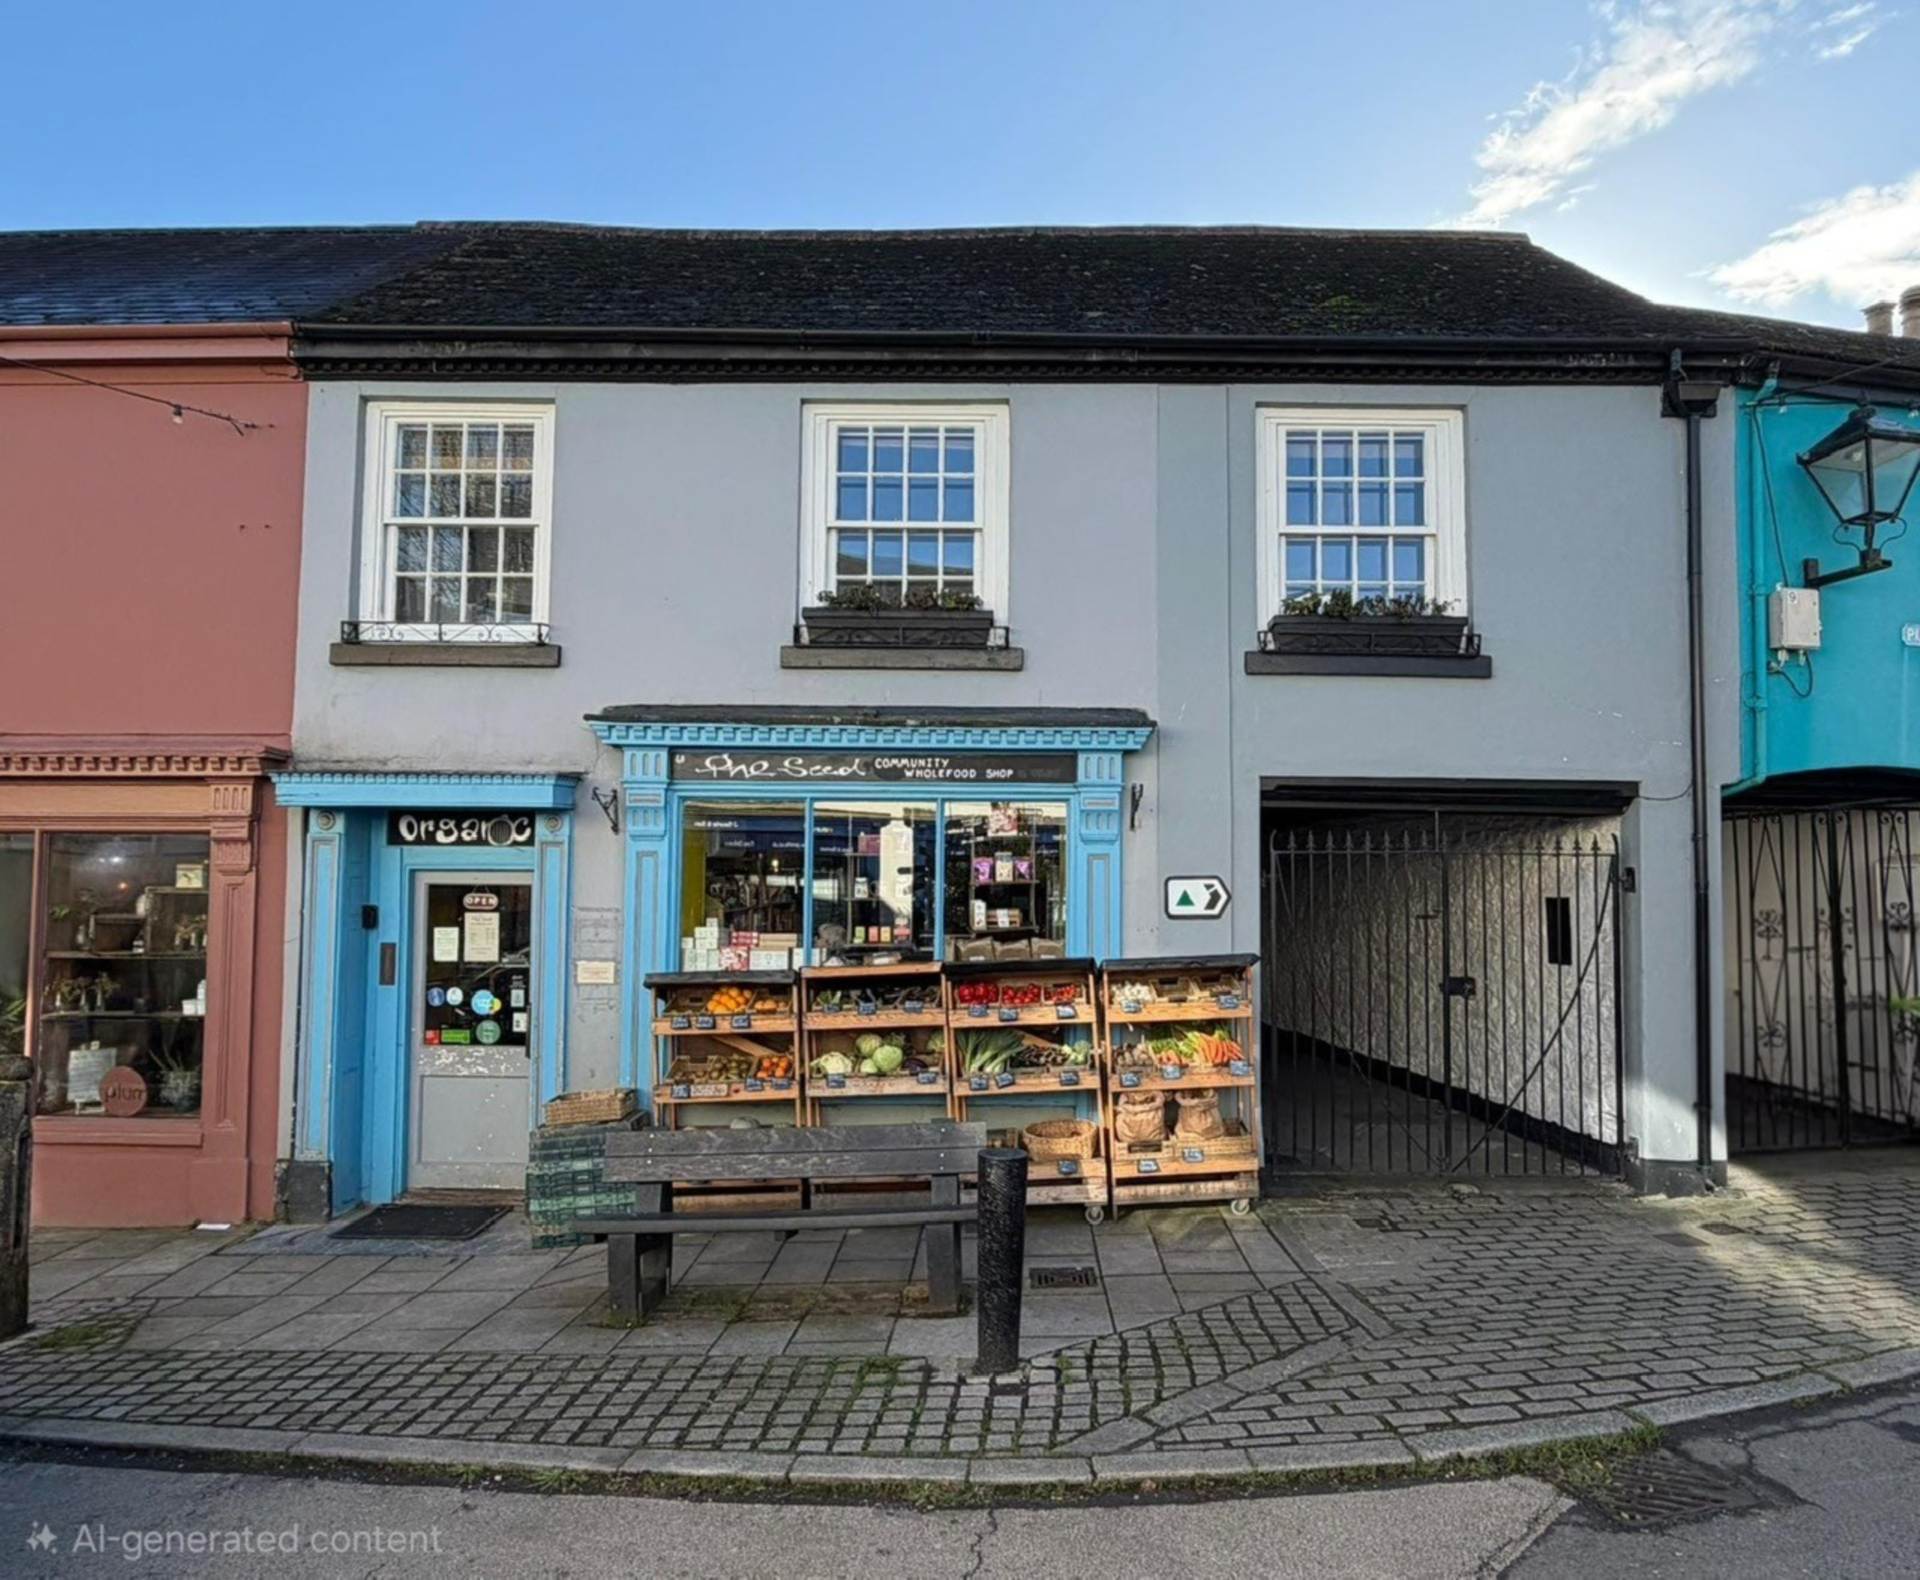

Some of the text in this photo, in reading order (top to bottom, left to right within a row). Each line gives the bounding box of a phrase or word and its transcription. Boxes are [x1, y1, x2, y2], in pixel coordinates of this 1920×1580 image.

[695, 753, 867, 779] The Seed
[874, 757, 950, 769] COMMUNITY
[904, 768, 977, 778] WHOLEFOOD
[985, 768, 1014, 779] SHOP
